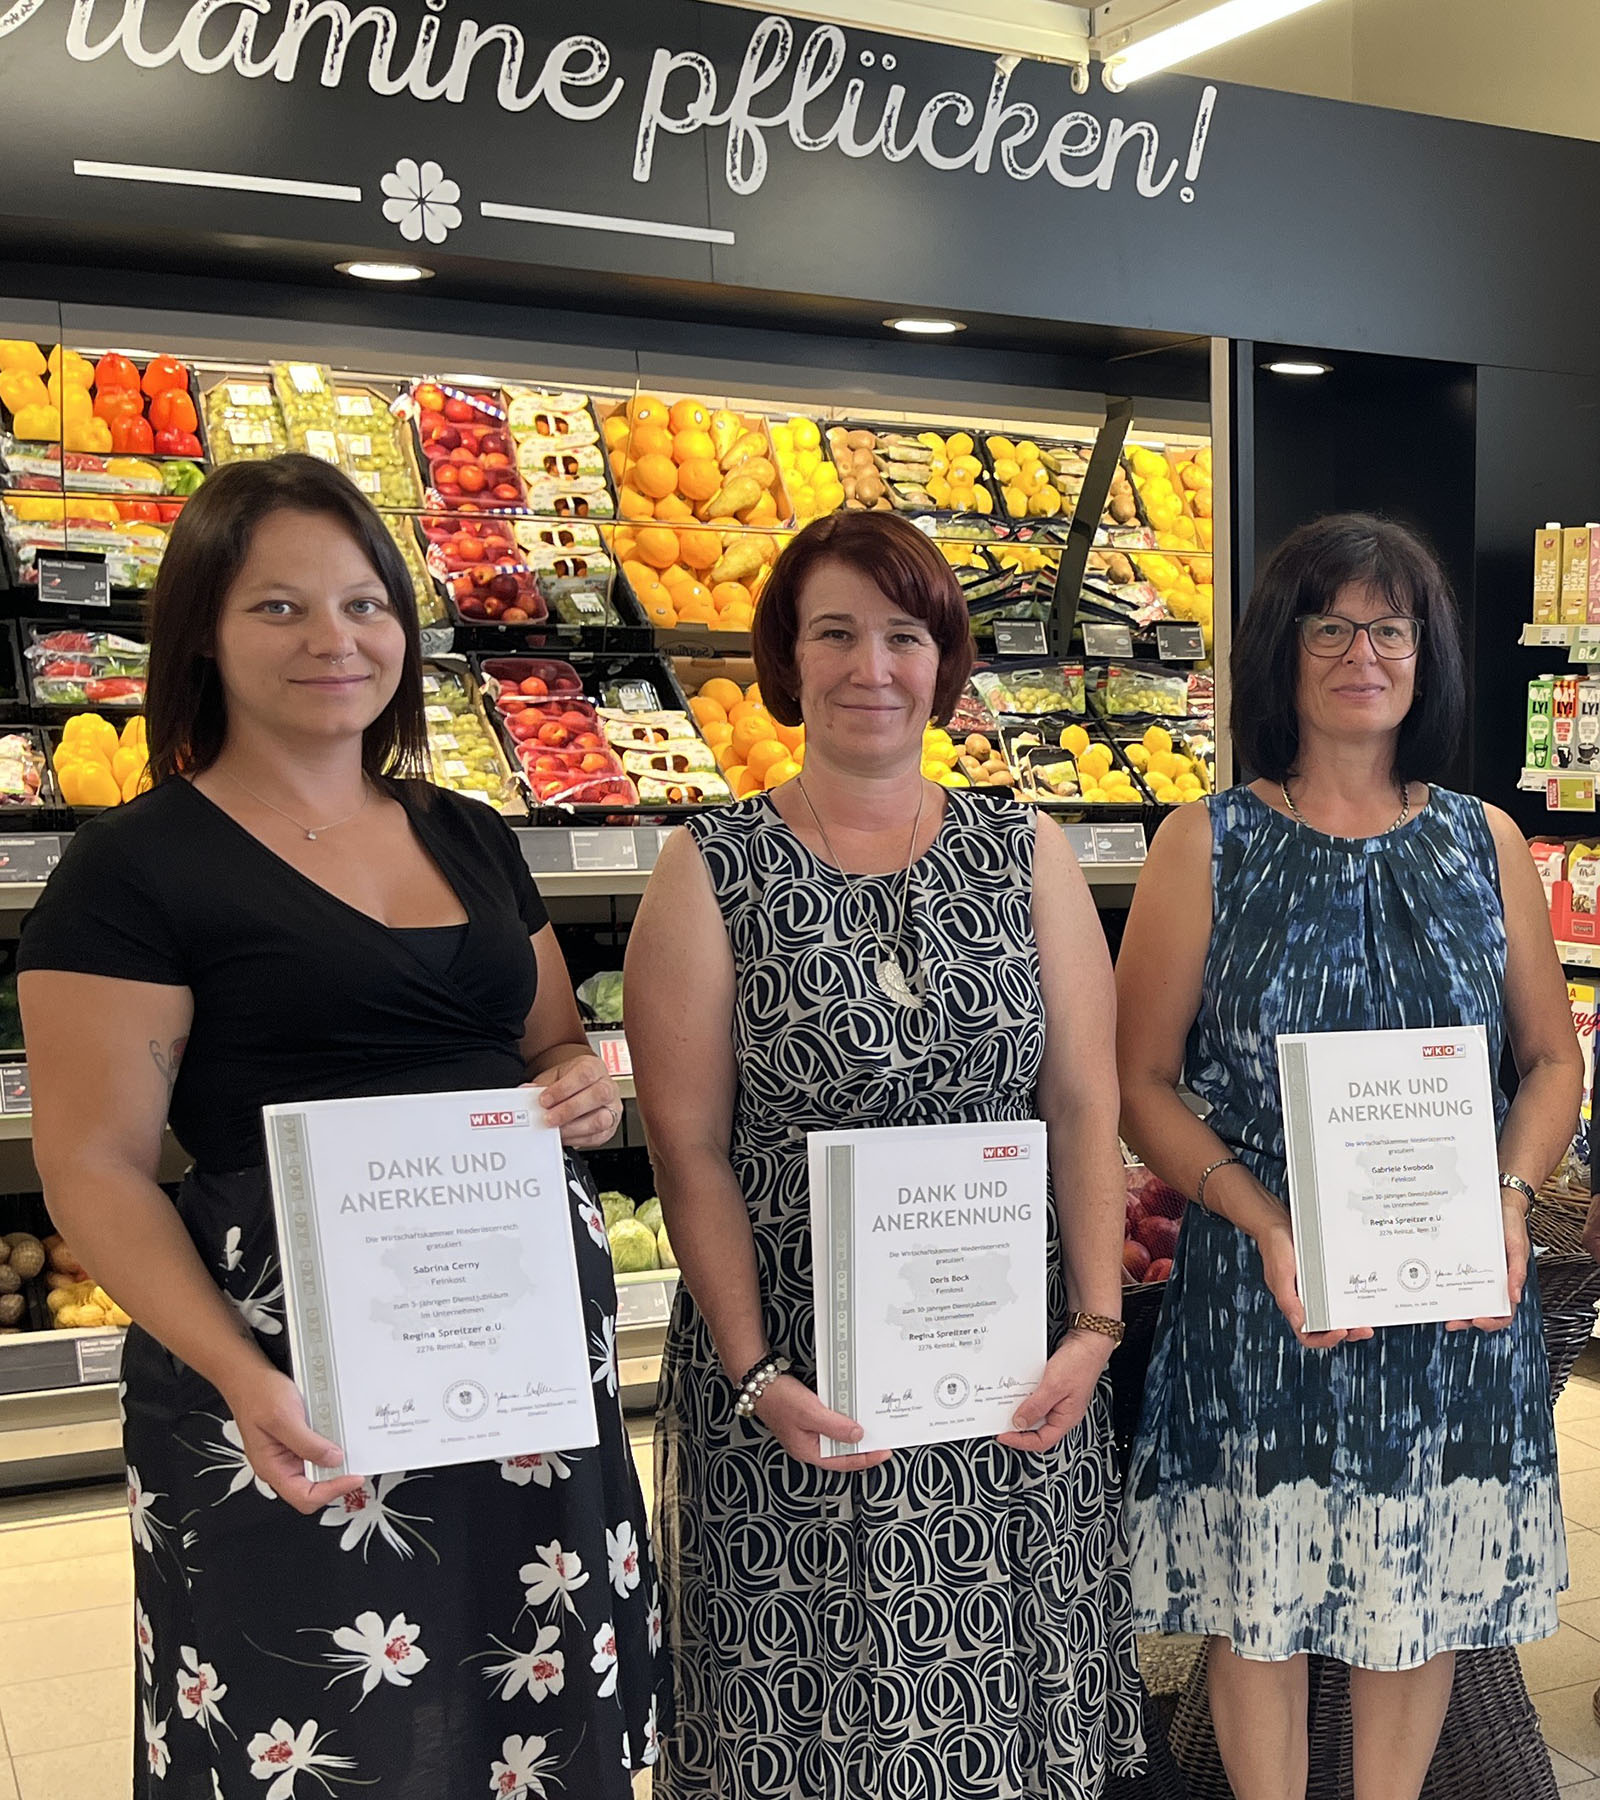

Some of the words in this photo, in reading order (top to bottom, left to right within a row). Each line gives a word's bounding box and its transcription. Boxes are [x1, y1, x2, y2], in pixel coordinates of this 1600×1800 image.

[632, 16, 1217, 203] pflücken!
[1532, 702, 1548, 714] LY!
[1556, 702, 1573, 715] LY!
[1582, 702, 1599, 715] LY!
[1423, 1046, 1455, 1057] WKO
[1348, 1080, 1402, 1099] DANK
[1408, 1078, 1449, 1095] UND
[470, 1112, 513, 1127] WKO
[1328, 1100, 1473, 1124] ANERKENNUNG
[984, 1146, 1017, 1159] WKO
[368, 1156, 443, 1182] DANK
[452, 1152, 507, 1175] UND
[1372, 1166, 1401, 1174] Gabriele
[1402, 1164, 1434, 1172] Swoboda
[340, 1178, 541, 1215] ANERKENNUNG
[898, 1184, 957, 1205] DANK
[964, 1180, 1008, 1200] UND
[872, 1204, 1032, 1233] ANERKENNUNG
[1370, 1218, 1394, 1227] Regina
[1395, 1216, 1428, 1226] Spreitzer
[380, 1228, 455, 1243] Wirtschaftskammer
[456, 1222, 519, 1237] Niederösterreich
[426, 1240, 462, 1252] gratuliert
[413, 1262, 450, 1275] Sabrina
[452, 1260, 480, 1274] Cerny
[431, 1276, 467, 1286] Feinkost
[930, 1276, 950, 1285] Doris
[952, 1274, 970, 1283] Bock
[452, 1291, 509, 1306] Dienstjubiläum
[433, 1306, 485, 1319] Unternehmen
[402, 1330, 436, 1344] Regina
[438, 1324, 484, 1340] Spreitzer
[485, 1323, 505, 1334] e.U.
[909, 1332, 935, 1342] Regina
[936, 1328, 971, 1340] Spreitzer
[973, 1326, 989, 1335] e.U.
